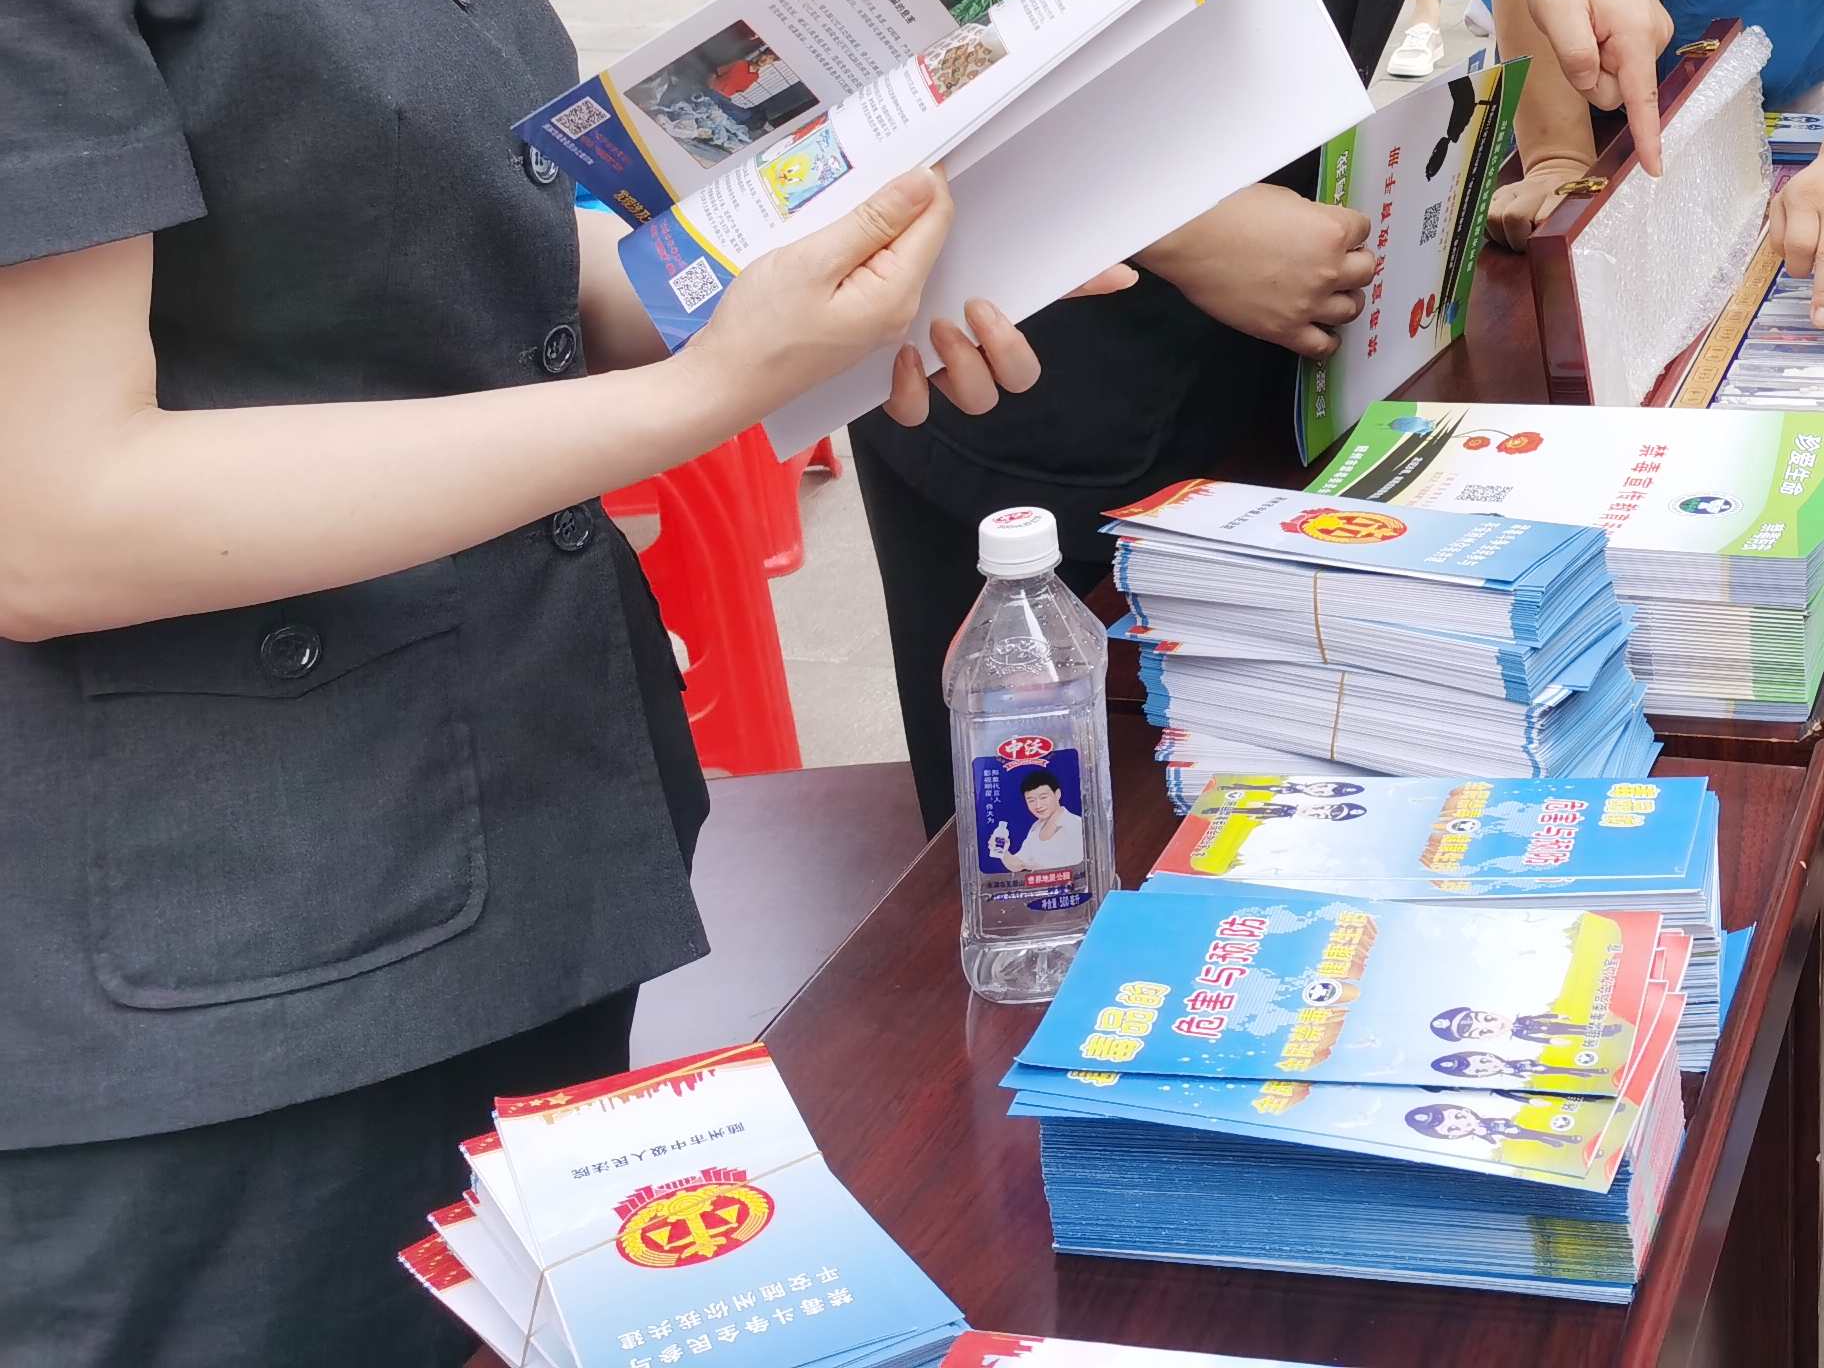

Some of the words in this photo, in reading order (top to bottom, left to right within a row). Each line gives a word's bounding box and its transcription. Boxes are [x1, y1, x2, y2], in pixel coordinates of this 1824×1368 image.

[1776, 432, 1824, 498] 珍爱生命
[1004, 738, 1047, 759] 中沃
[1171, 914, 1267, 1039] 危害与预防
[1080, 979, 1172, 1064] 毒品的
[571, 1121, 745, 1181] 随州市中级人民法院
[617, 1265, 841, 1351] 平安随州你我共建
